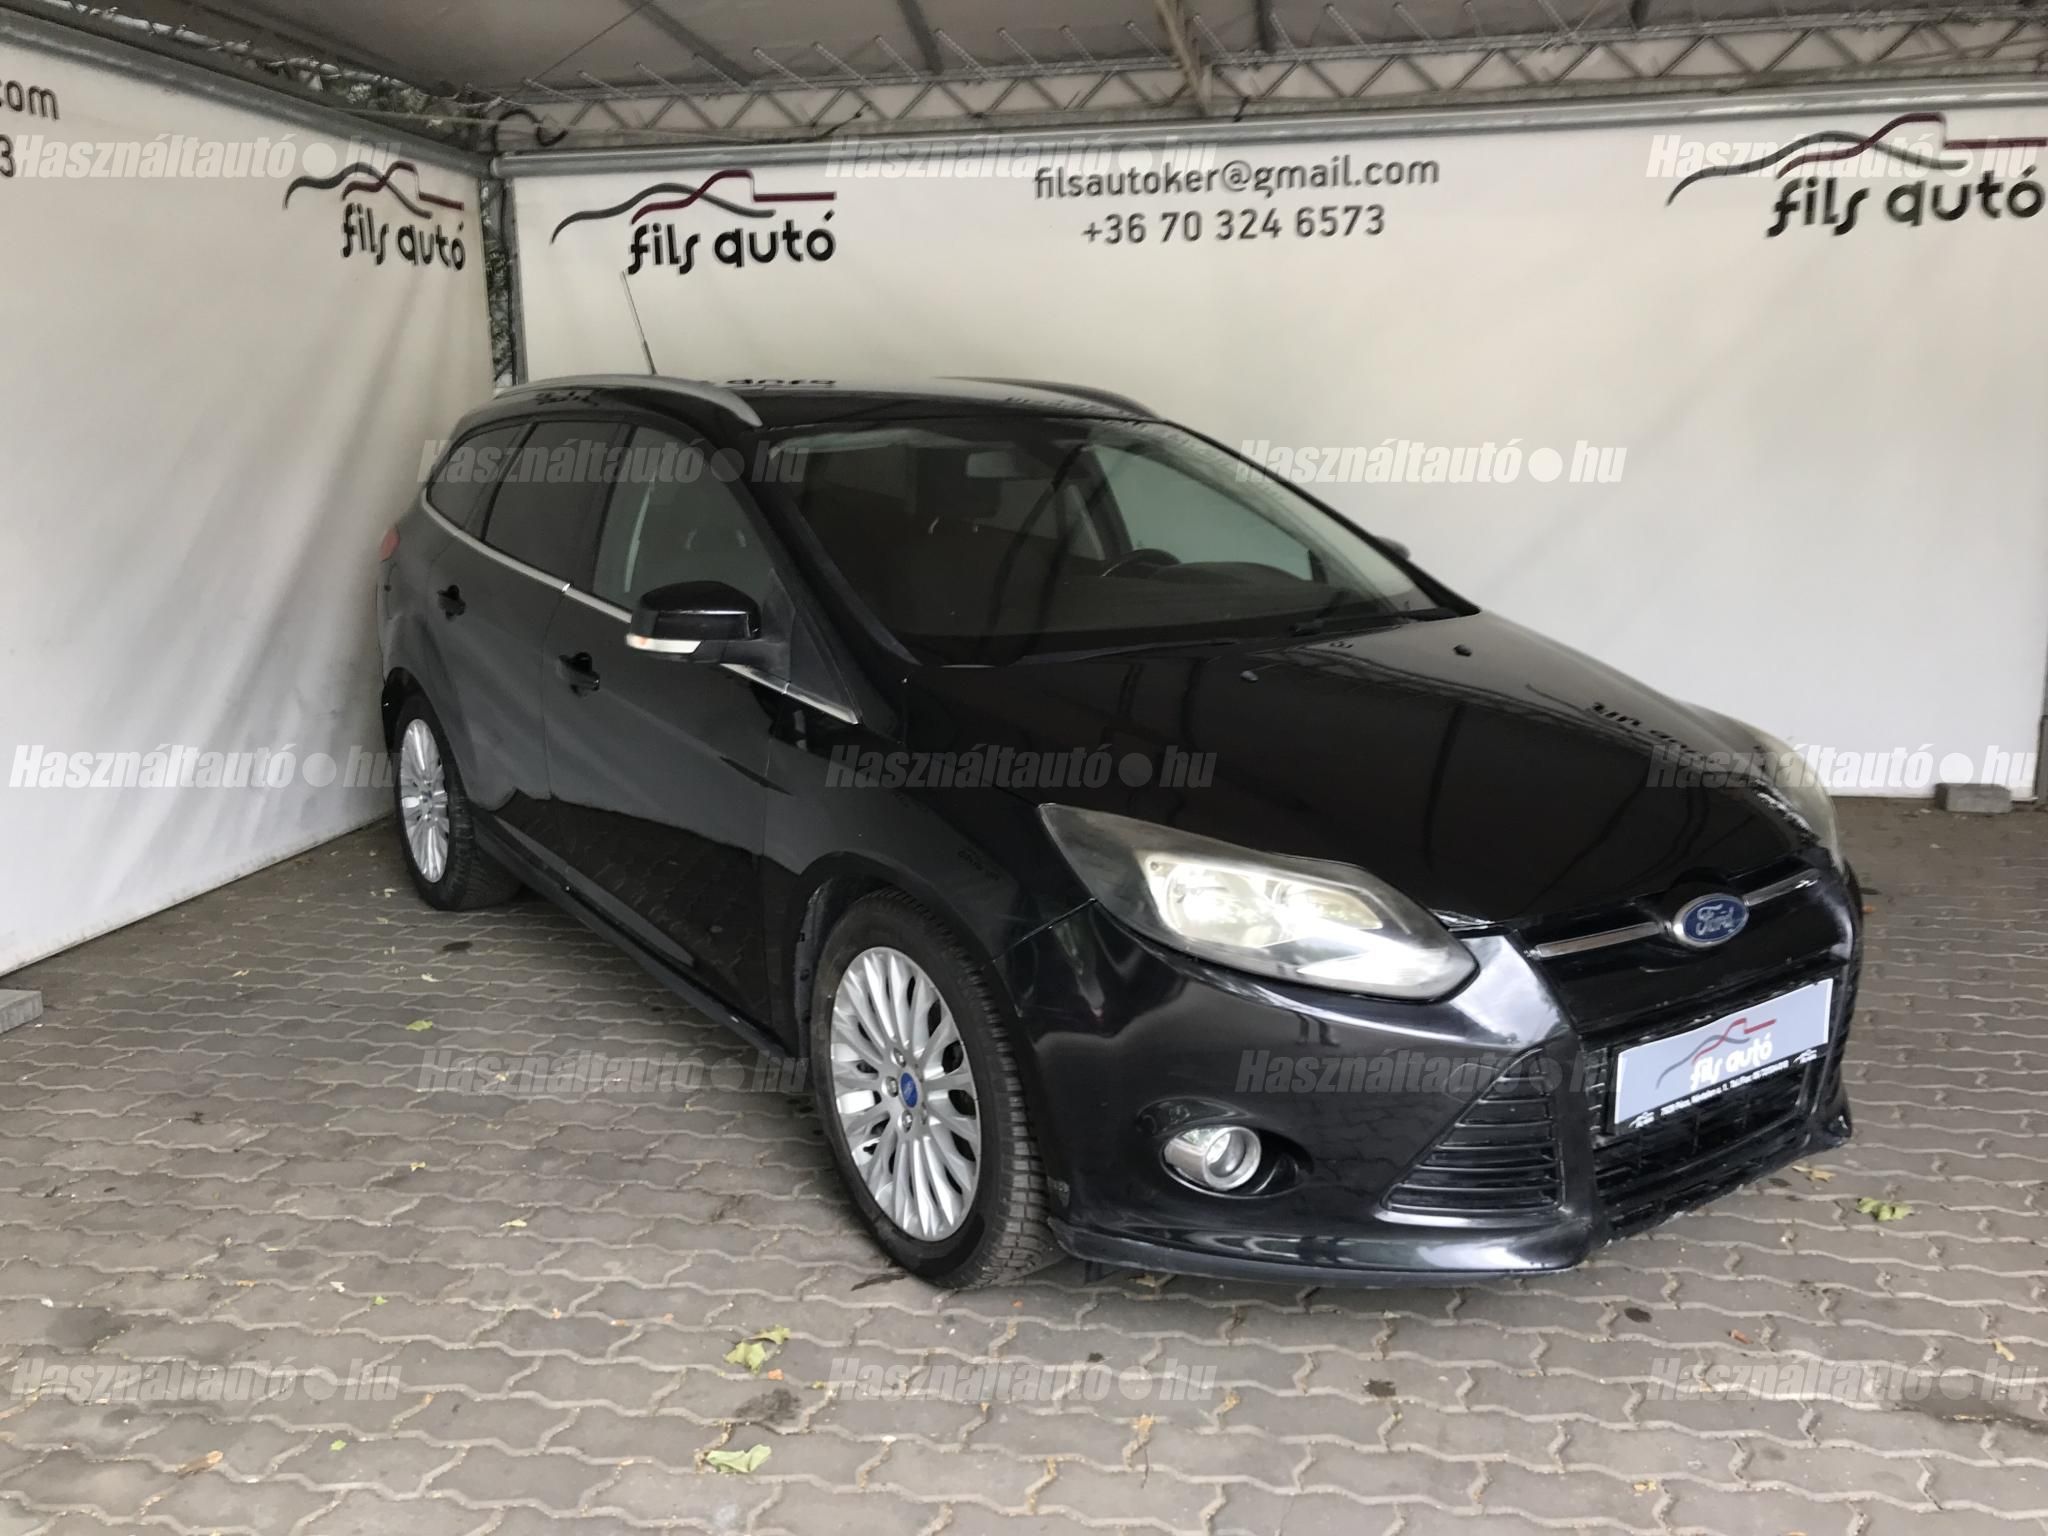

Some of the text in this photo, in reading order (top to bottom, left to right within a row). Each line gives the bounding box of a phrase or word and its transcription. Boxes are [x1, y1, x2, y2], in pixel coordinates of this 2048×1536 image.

[0, 80, 60, 120] om
[1034, 155, 1440, 199] filsautoker@gmail.com
[1764, 164, 2047, 238] fils autó
[342, 202, 466, 271] fils autó
[627, 209, 836, 275] fils autó
[1082, 203, 1386, 244] +36 70 324 6573
[1695, 903, 1736, 936] Ford
